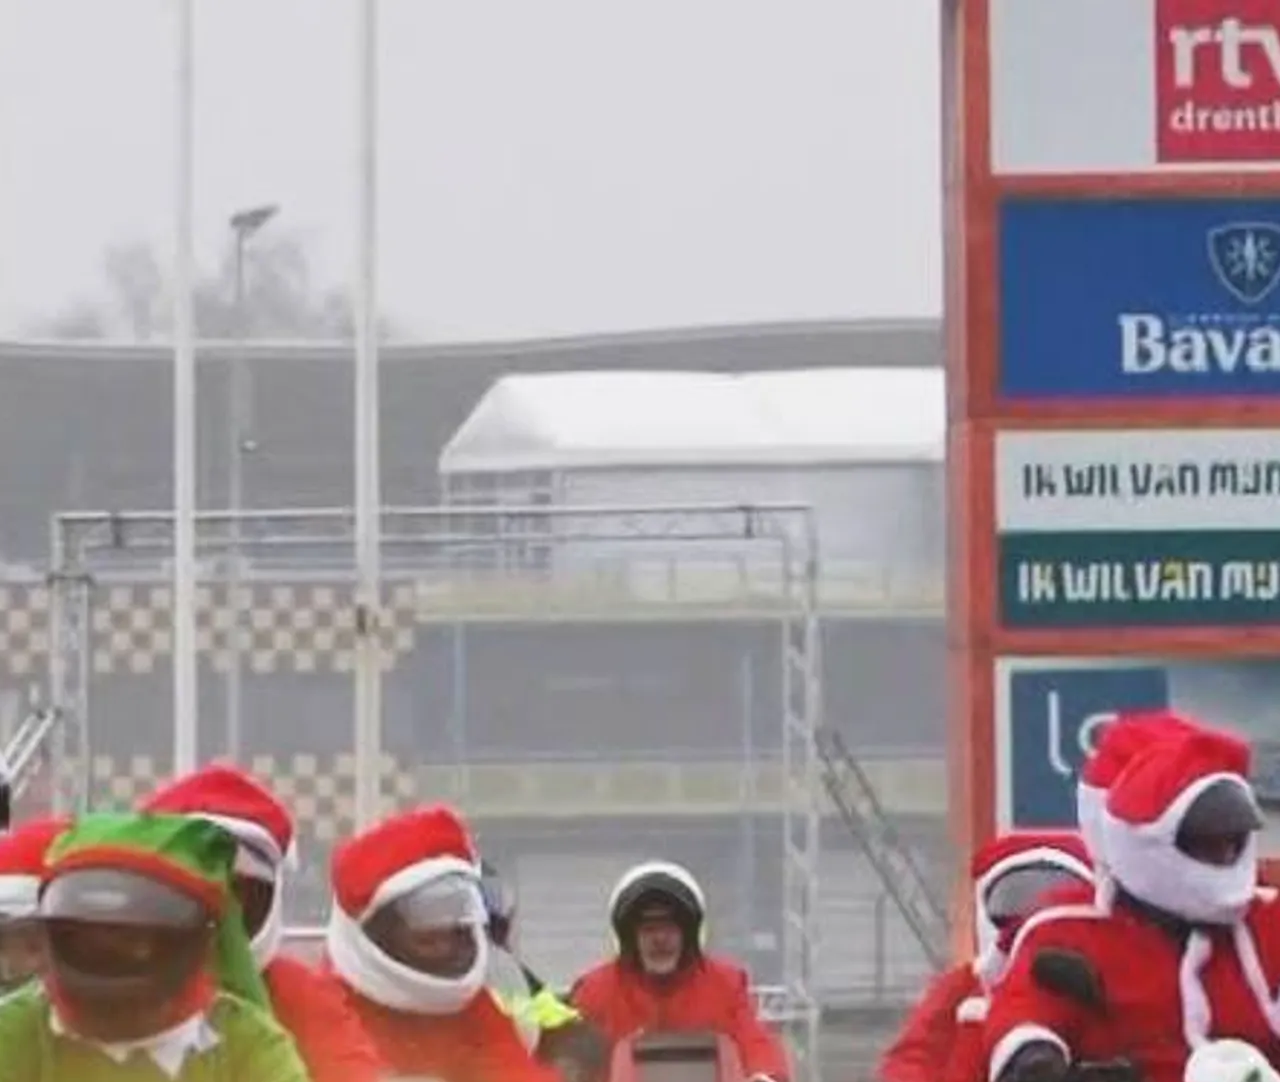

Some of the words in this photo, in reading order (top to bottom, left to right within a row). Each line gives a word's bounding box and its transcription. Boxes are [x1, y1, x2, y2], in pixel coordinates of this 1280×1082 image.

[1023, 463, 1056, 497] IK
[1064, 463, 1120, 497] WIL
[1130, 462, 1200, 497] VAN
[1019, 560, 1056, 603] IK
[1061, 560, 1130, 603] WIL
[1134, 558, 1214, 603] VAN
